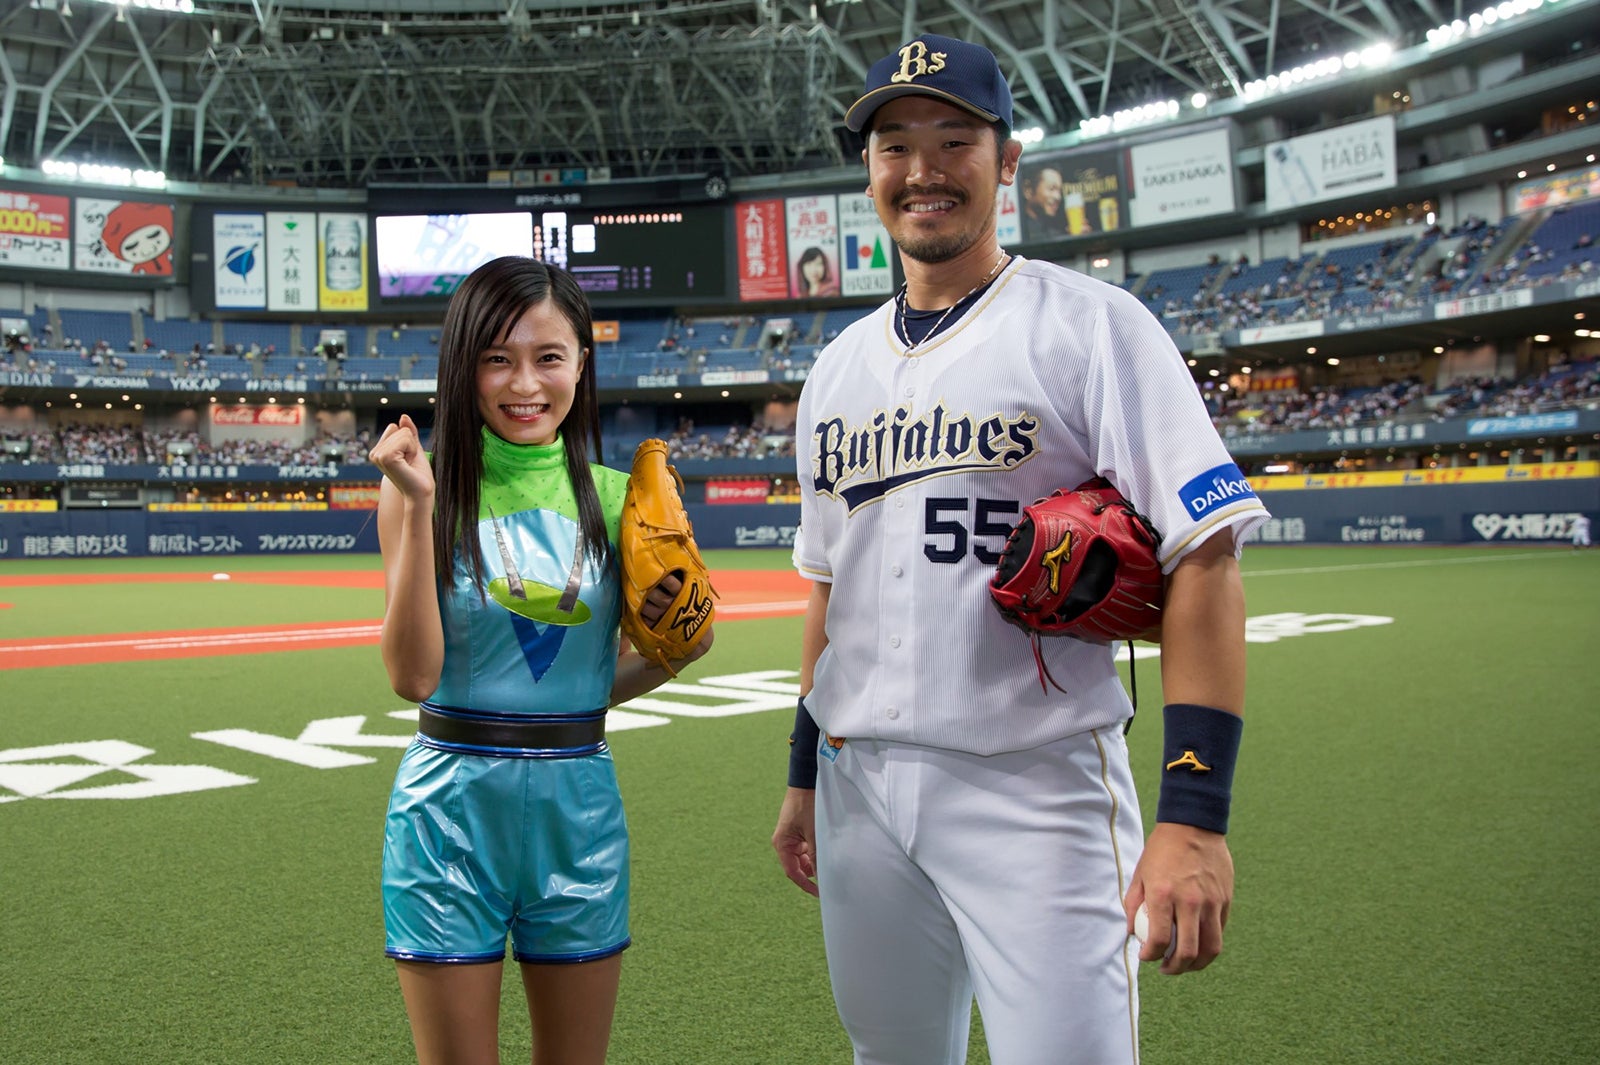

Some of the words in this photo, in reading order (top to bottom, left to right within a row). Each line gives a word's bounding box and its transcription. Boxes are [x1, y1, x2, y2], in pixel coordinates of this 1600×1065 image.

[891, 41, 947, 83] Bs
[1321, 141, 1383, 172] HABA
[1142, 162, 1226, 189] TAKENAKA
[282, 244, 302, 306] 大林組
[92, 376, 149, 388] YOKOHAMA
[169, 377, 199, 390] YKK
[200, 377, 220, 390] AP
[1327, 424, 1425, 445] 大阪信用金庫
[813, 398, 1041, 501] Buffaloes
[278, 462, 338, 478] オリオンビール
[924, 497, 1018, 564] 55
[1341, 525, 1377, 541] Ever
[1380, 525, 1424, 541] Drive
[23, 534, 128, 556] 能美防災
[148, 534, 242, 553] 新成トラスト
[258, 534, 355, 550] プレサンスマンション
